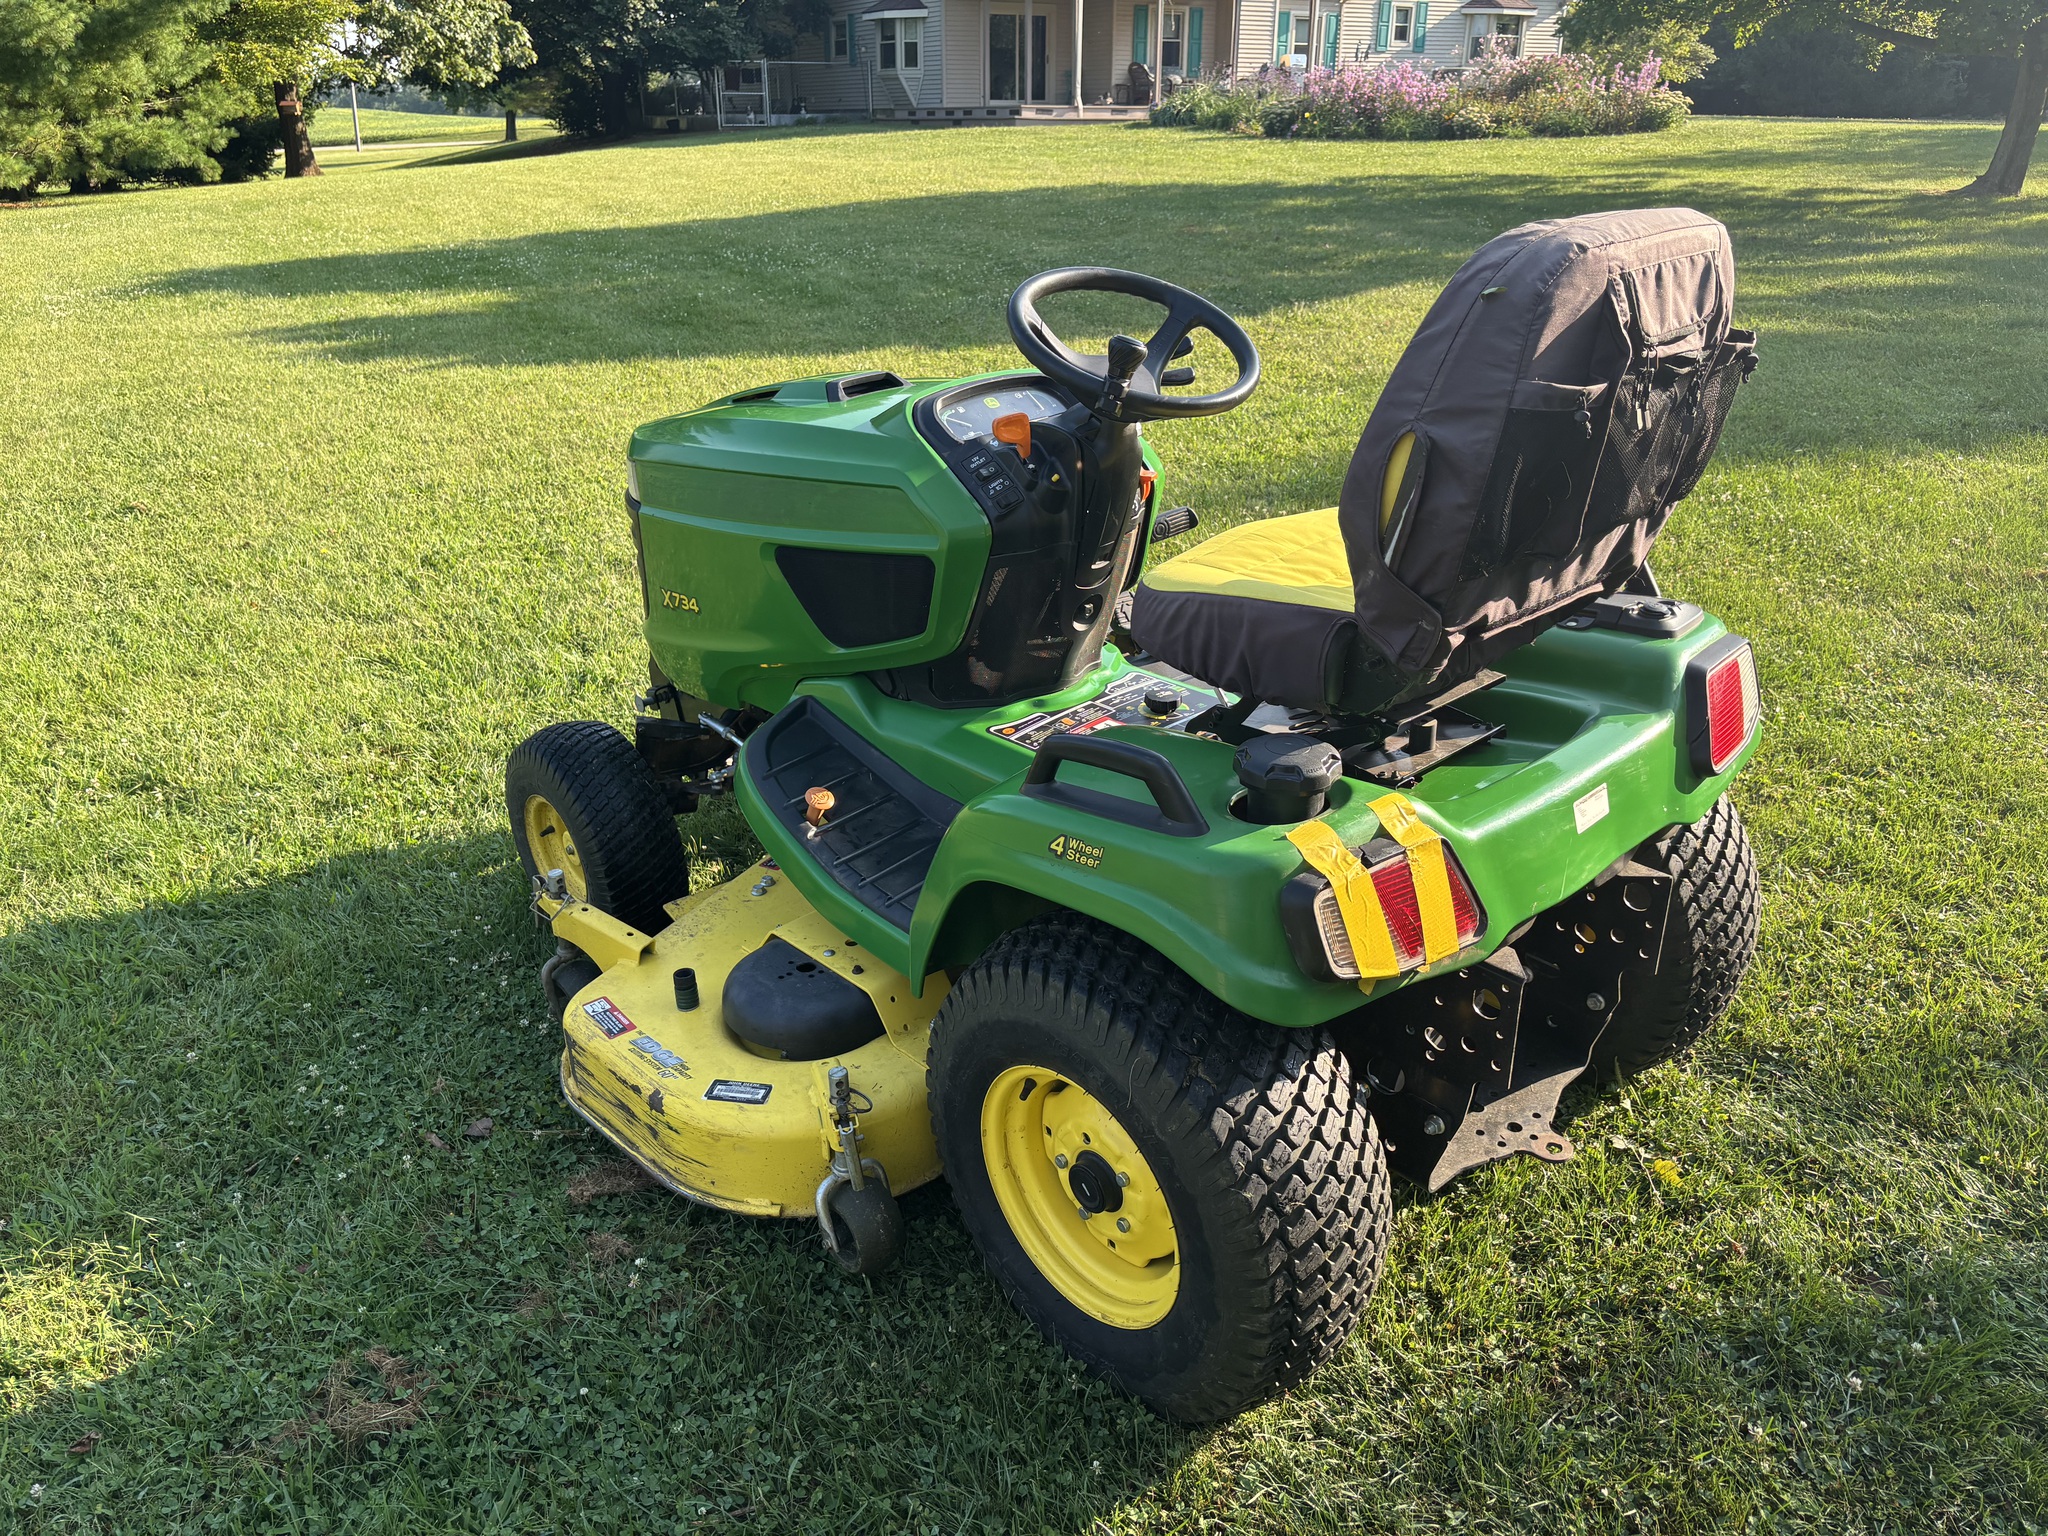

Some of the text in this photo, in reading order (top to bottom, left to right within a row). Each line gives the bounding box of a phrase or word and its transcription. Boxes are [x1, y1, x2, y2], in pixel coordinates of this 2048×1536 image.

[988, 479, 1004, 489] LIGHTS
[661, 588, 700, 613] X734
[1049, 836, 1104, 858] 4 Wheel
[1066, 849, 1101, 868] Steer
[629, 1035, 686, 1069] EDGE
